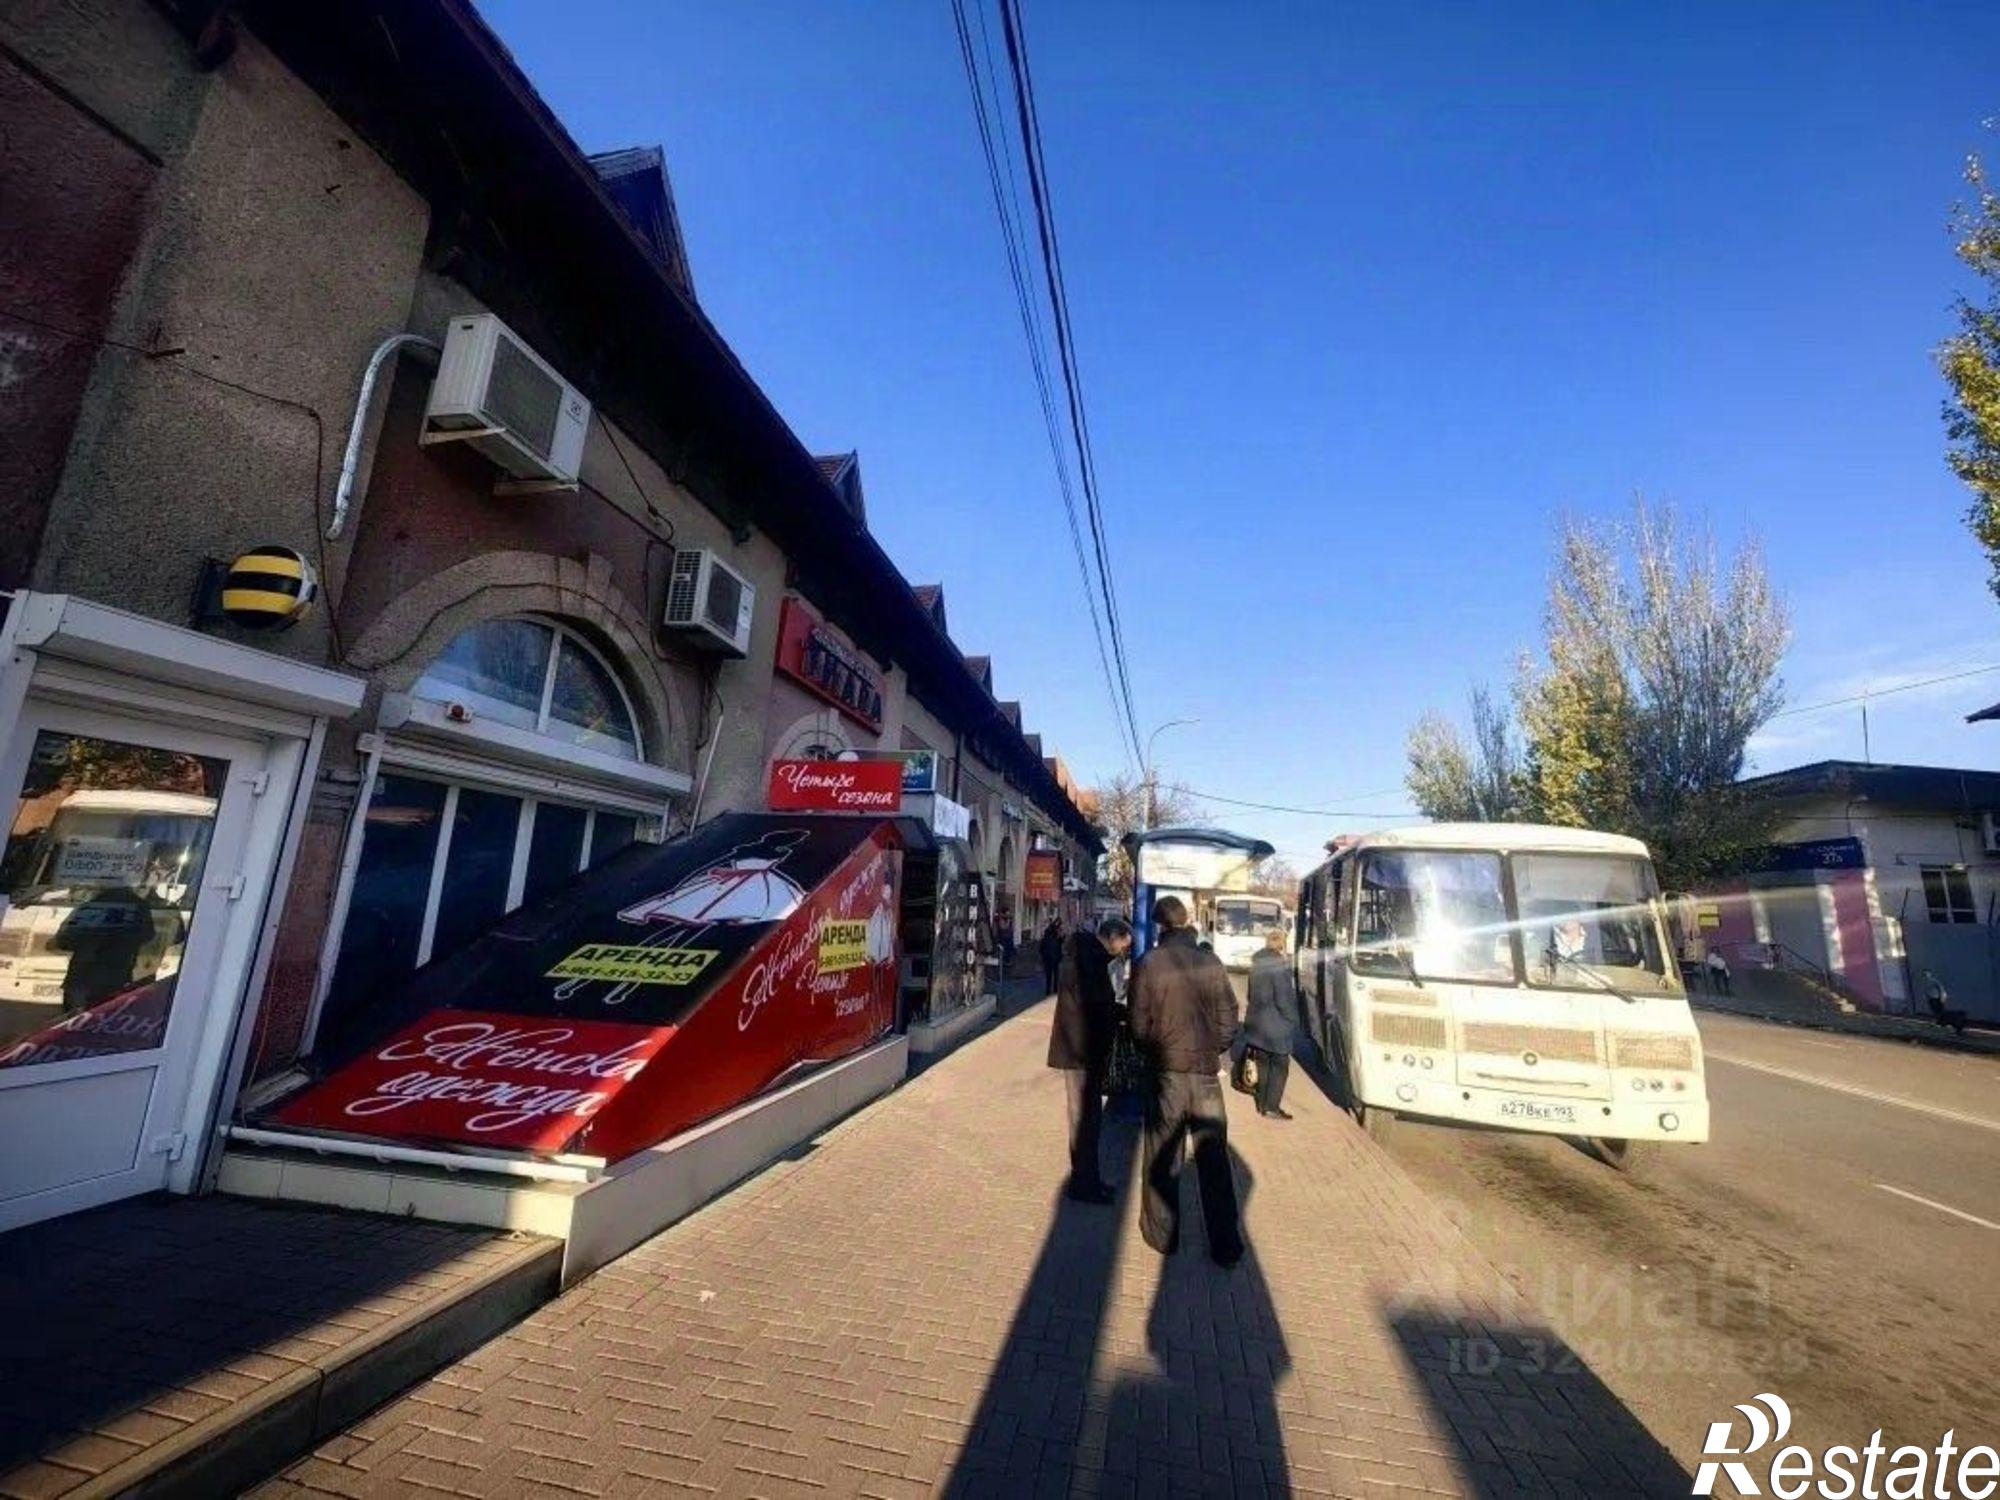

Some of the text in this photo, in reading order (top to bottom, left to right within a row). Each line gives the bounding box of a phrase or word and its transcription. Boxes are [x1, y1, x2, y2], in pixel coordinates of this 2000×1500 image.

[778, 764, 855, 797] Четыре
[822, 923, 867, 946] АРЕНДА
[571, 949, 708, 967] АРЕНДА
[344, 1070, 609, 1131] одежда
